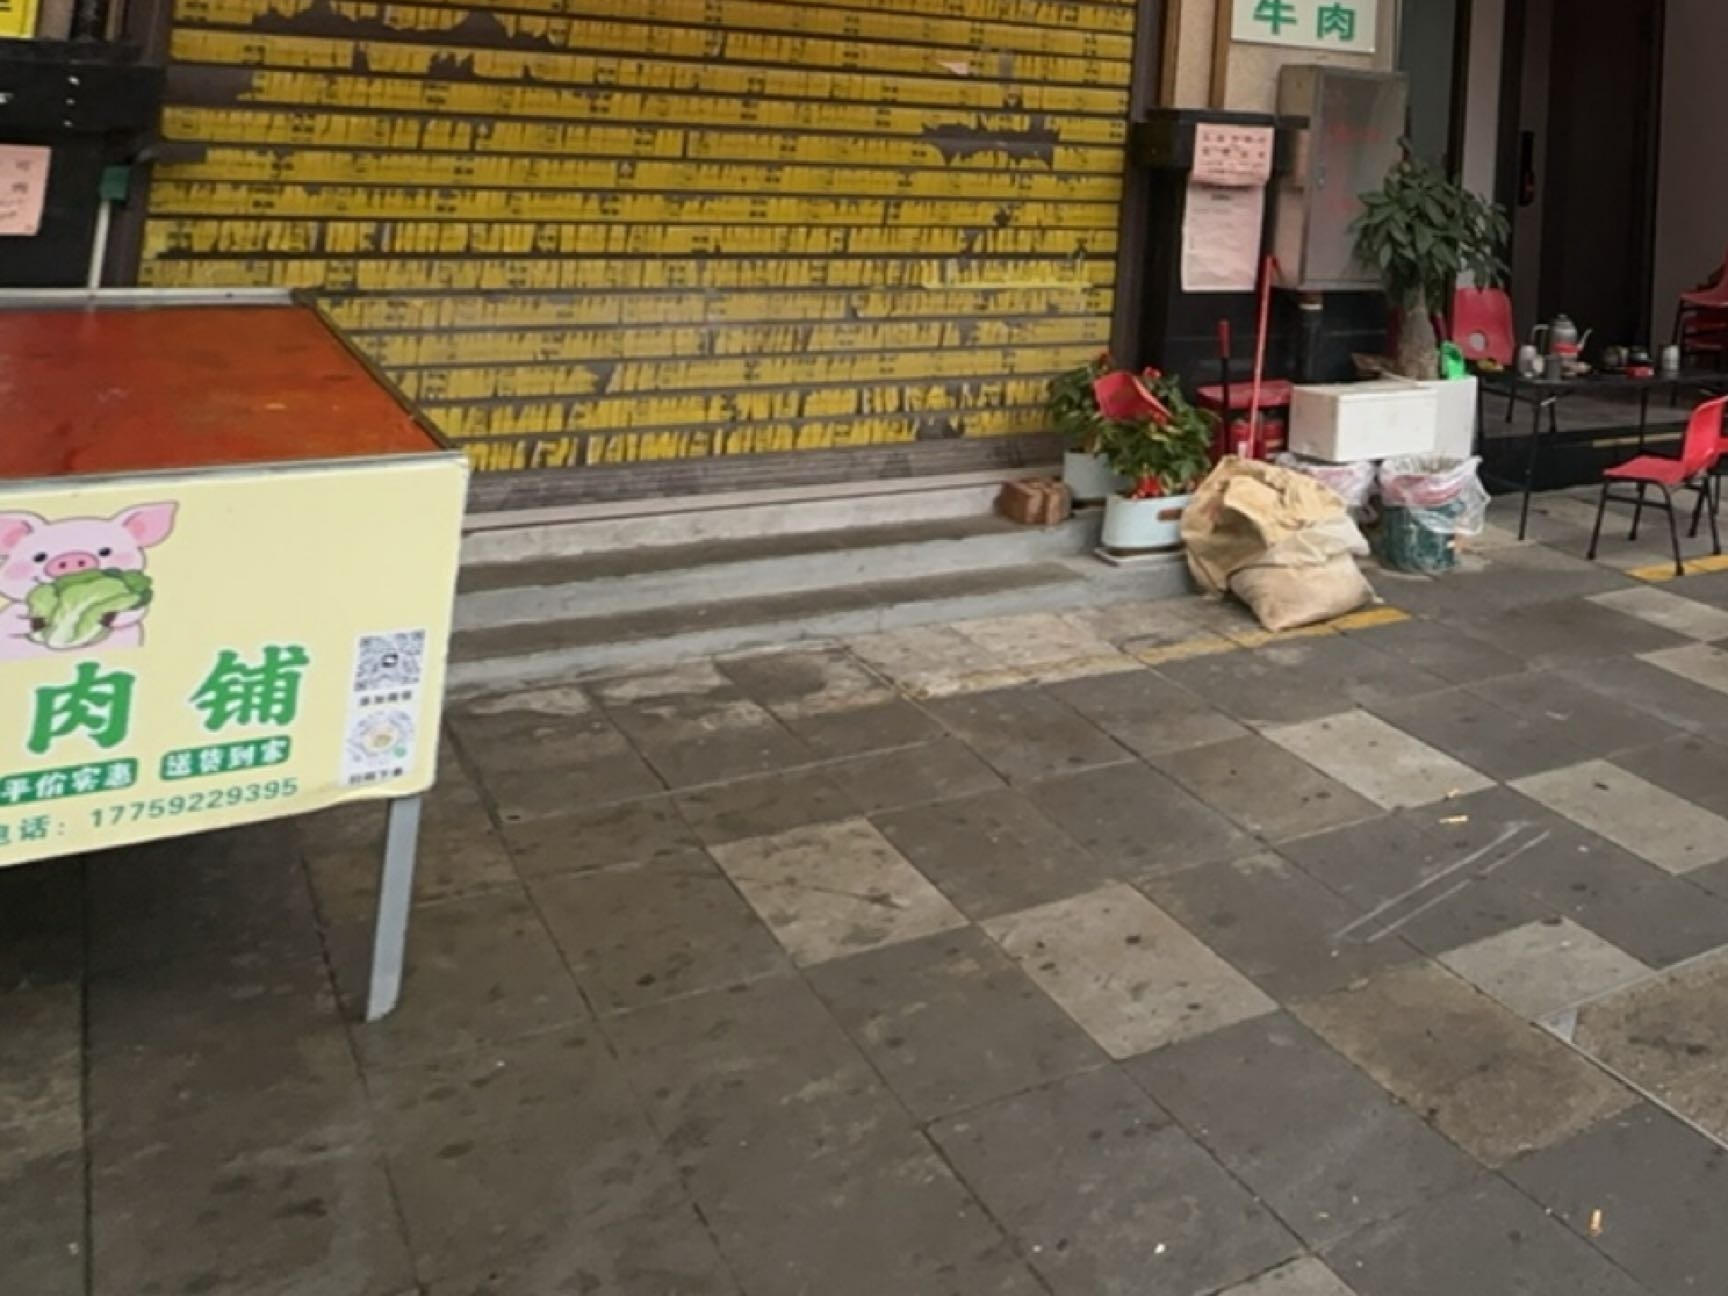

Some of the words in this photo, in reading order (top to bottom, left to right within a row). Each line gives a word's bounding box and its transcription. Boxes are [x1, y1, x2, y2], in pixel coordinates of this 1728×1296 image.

[27, 644, 310, 756] 肉铺
[166, 739, 288, 776] 送货到家
[1, 761, 133, 802] 平价实惠
